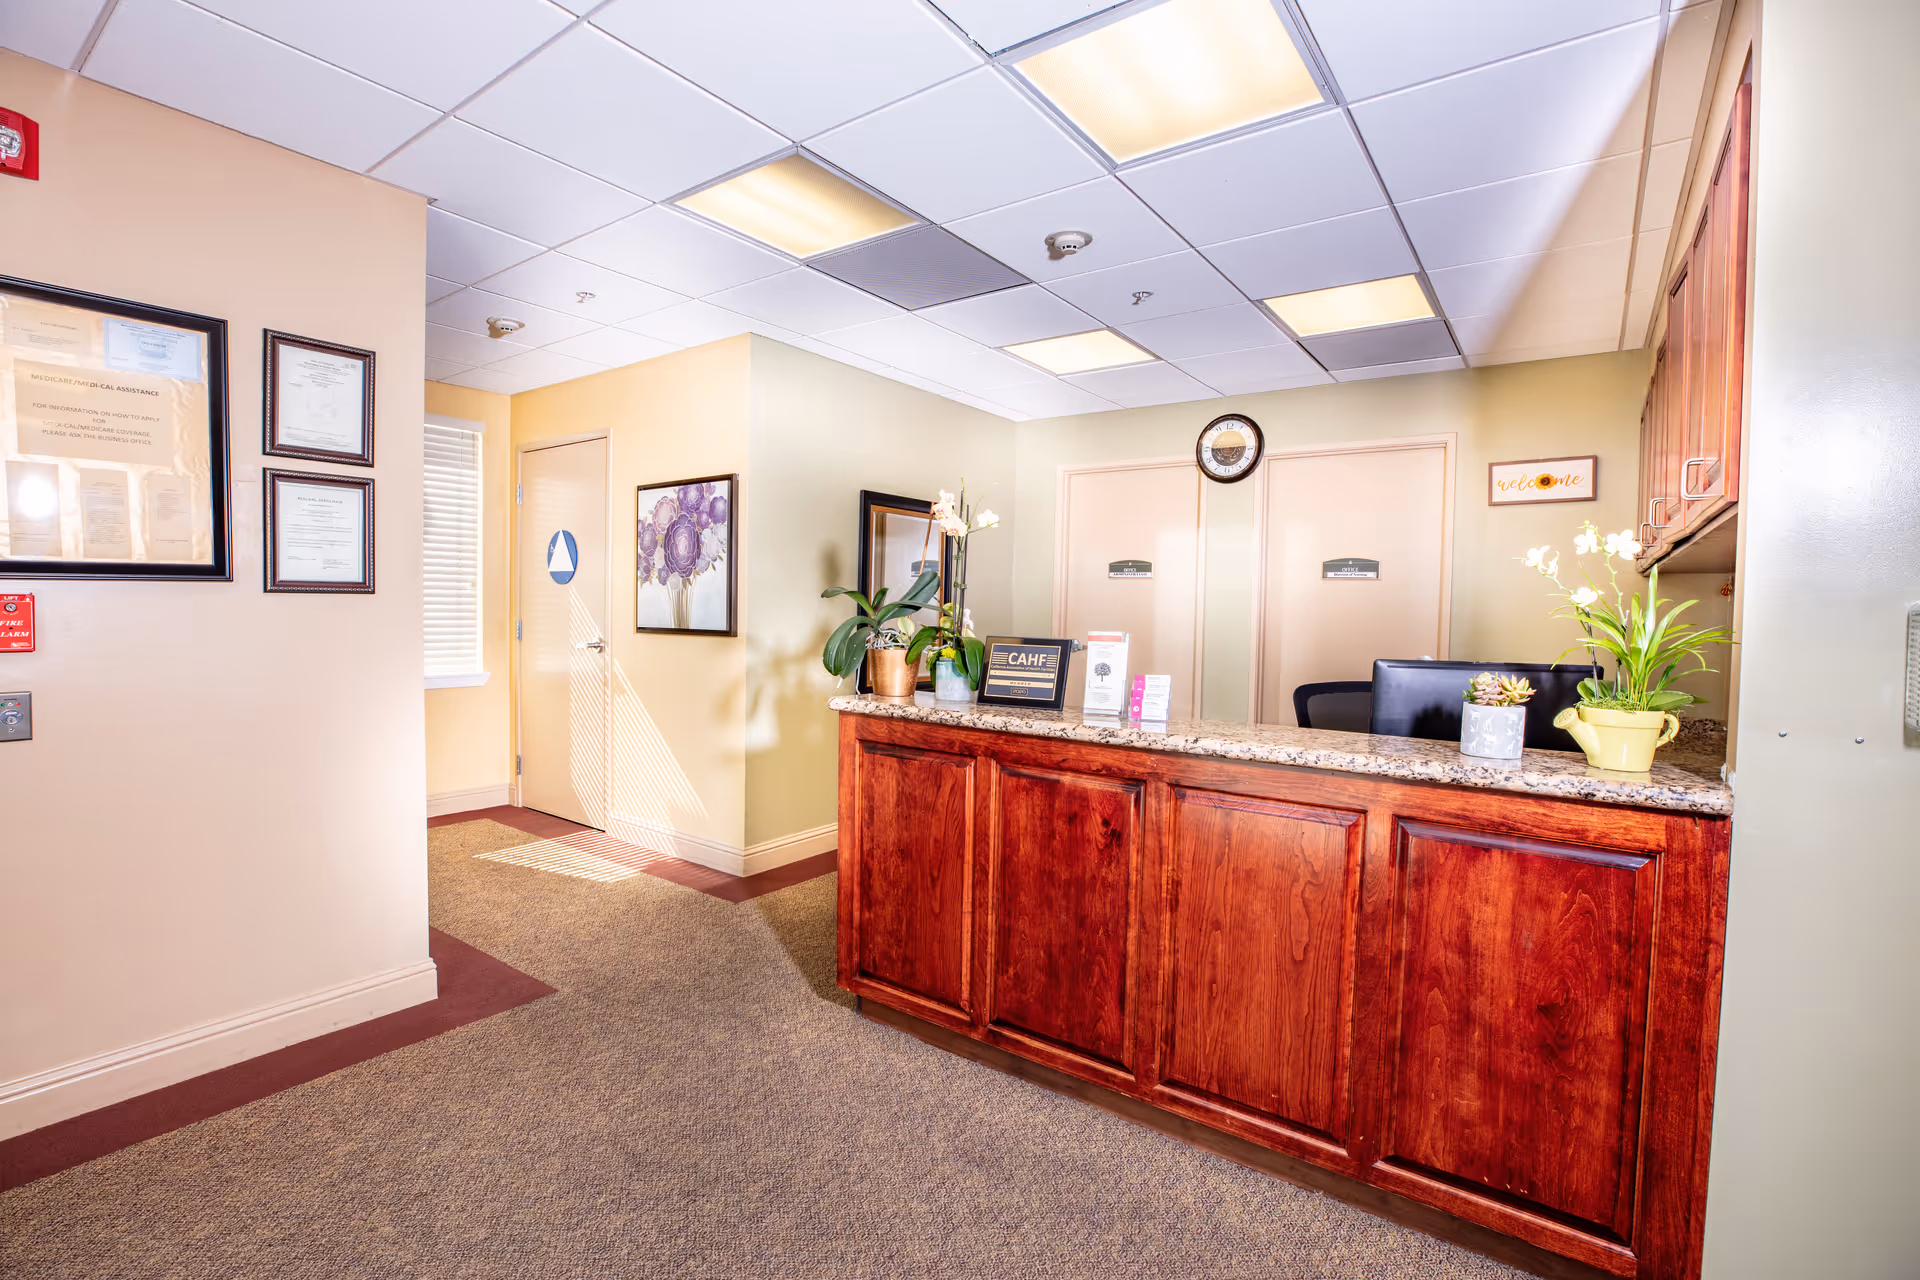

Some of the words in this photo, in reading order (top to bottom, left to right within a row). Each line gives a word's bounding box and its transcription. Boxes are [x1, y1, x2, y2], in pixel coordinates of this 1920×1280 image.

[31, 373, 115, 391] MEDICARE/MEDI-CAL
[116, 385, 160, 397] ASSISTANCE
[48, 404, 99, 416] INFORMATION
[140, 415, 160, 423] APPLY
[42, 429, 67, 437] PLEASE
[68, 431, 82, 439] ASK
[98, 434, 129, 444] BUSINESS
[130, 437, 153, 446] OFFICE
[1008, 652, 1047, 666] CAHF
